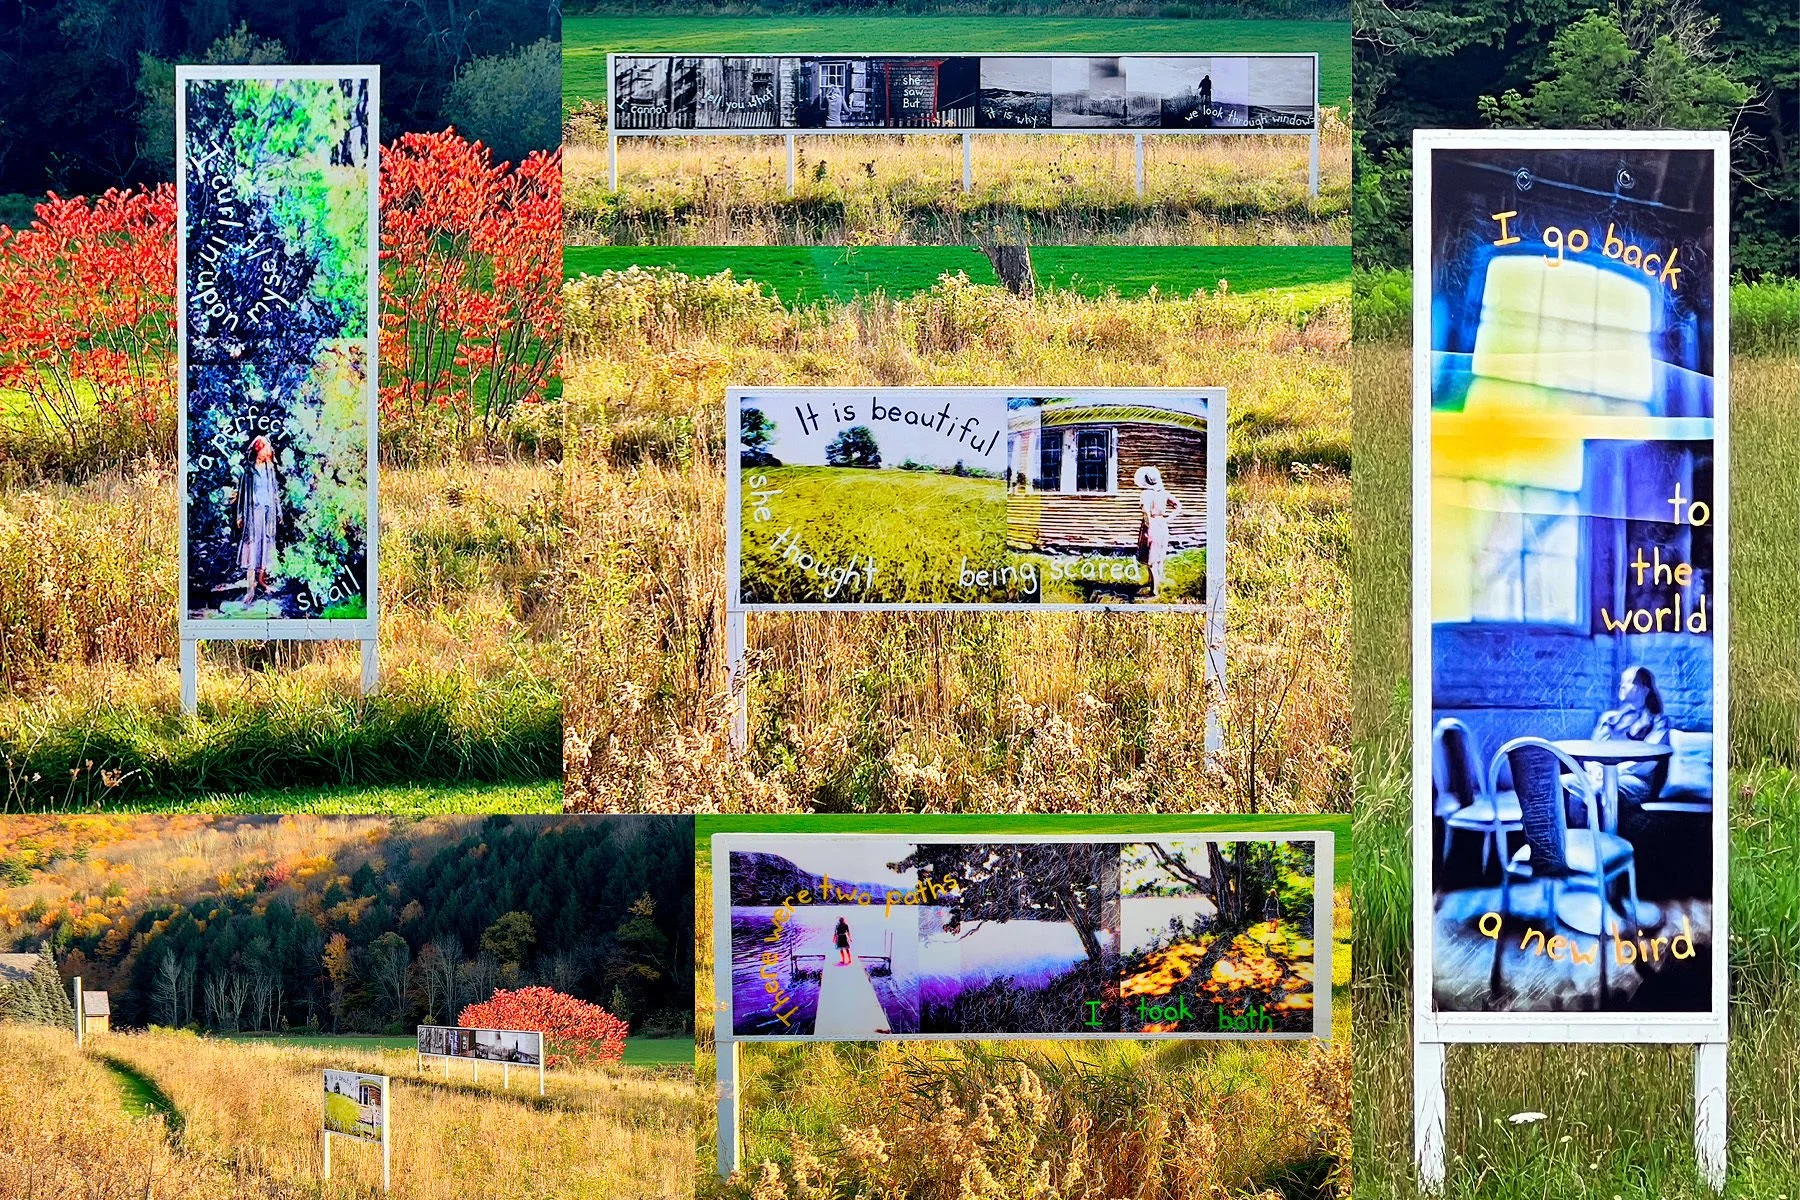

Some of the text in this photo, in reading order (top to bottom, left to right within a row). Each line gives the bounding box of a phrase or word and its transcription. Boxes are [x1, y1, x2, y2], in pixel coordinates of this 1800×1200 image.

[903, 74, 920, 85] she
[630, 102, 668, 114] cannot
[703, 88, 775, 113] tell you what
[903, 98, 920, 108] But
[1003, 108, 1013, 119] is
[1015, 113, 1037, 128] why
[1185, 105, 1315, 129] we look through windows
[190, 140, 290, 332] I curl in upon myself
[1492, 210, 1681, 290] I go back
[199, 405, 292, 469] a perfect
[795, 396, 1000, 457] It is beautiful
[1668, 482, 1710, 526] to
[749, 474, 878, 598] she thought
[958, 556, 1142, 595] being scared
[1631, 546, 1692, 586] the
[297, 565, 361, 611] snail
[1601, 593, 1707, 634] world
[760, 873, 958, 1027] There were two paths
[1479, 911, 1696, 967] a new bird
[1084, 995, 1273, 1031] I took both
